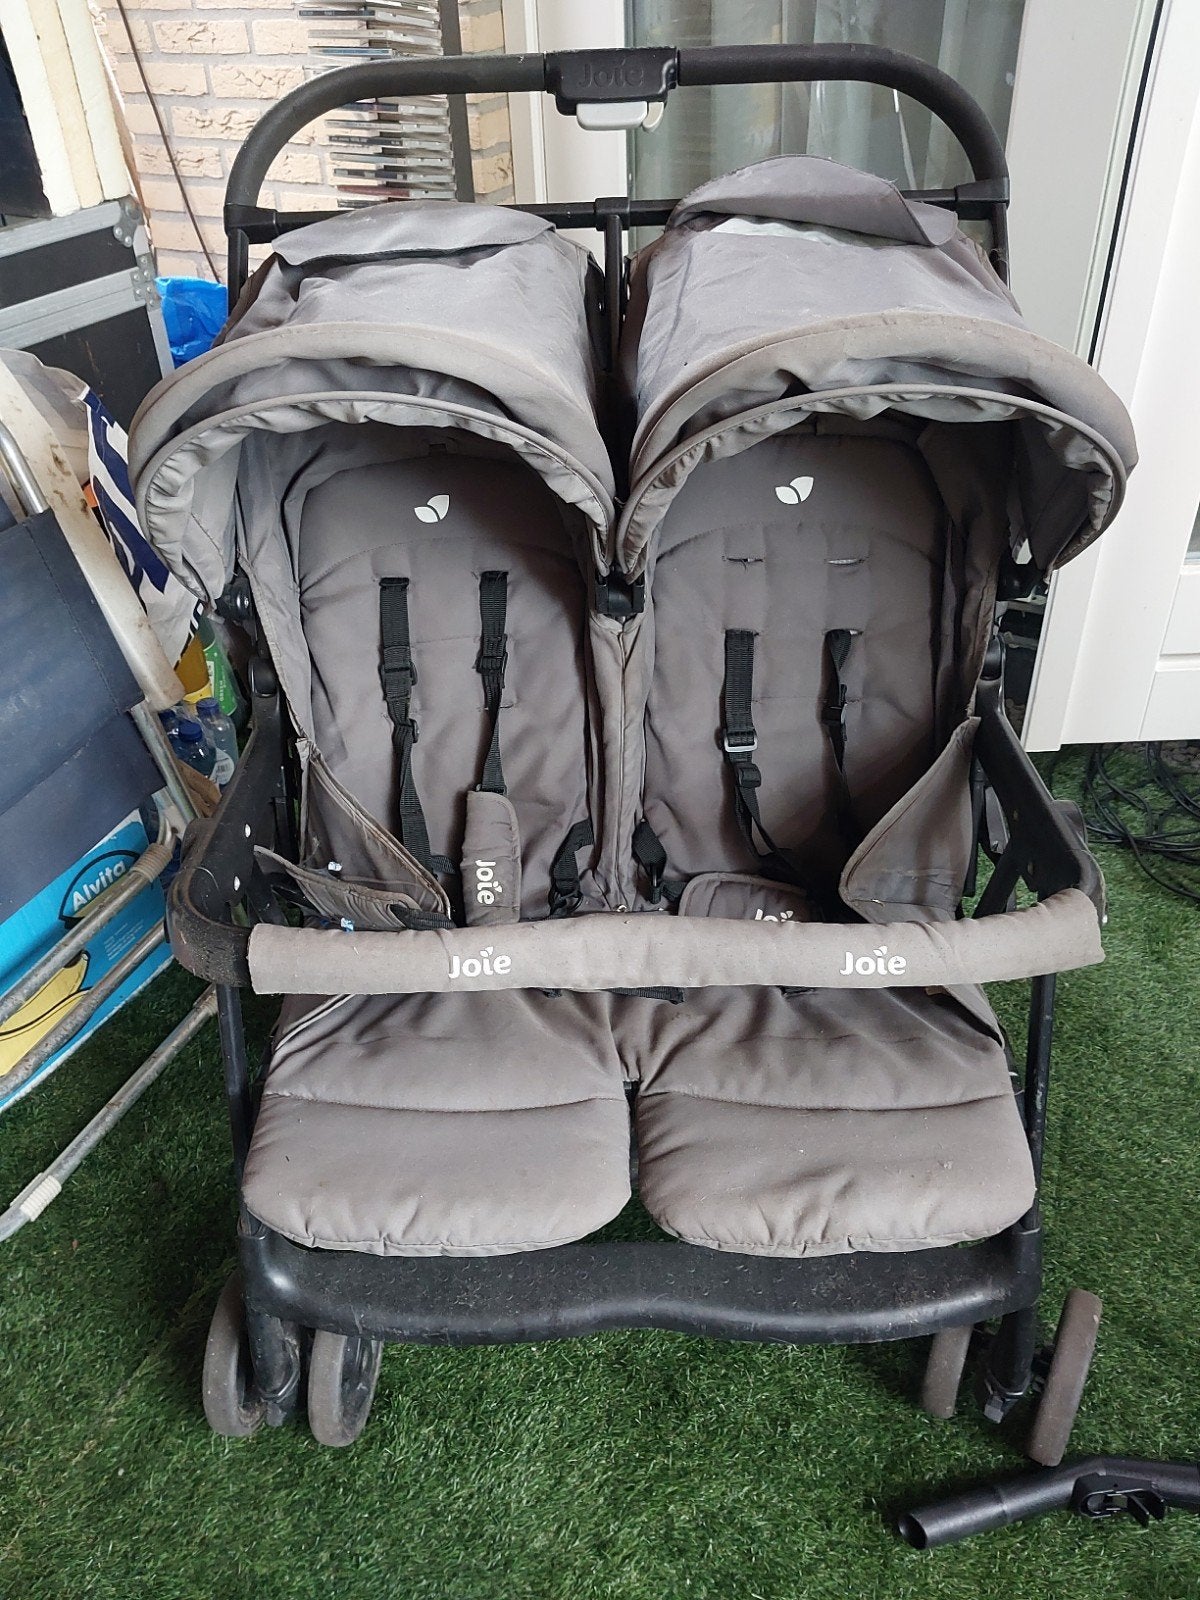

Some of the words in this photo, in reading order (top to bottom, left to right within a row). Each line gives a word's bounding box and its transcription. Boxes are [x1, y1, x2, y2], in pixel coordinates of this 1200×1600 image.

[578, 57, 644, 88] Joie
[72, 860, 127, 912] Alvita
[475, 859, 503, 905] Joie
[448, 946, 512, 979] Joie
[840, 945, 907, 976] Joie
